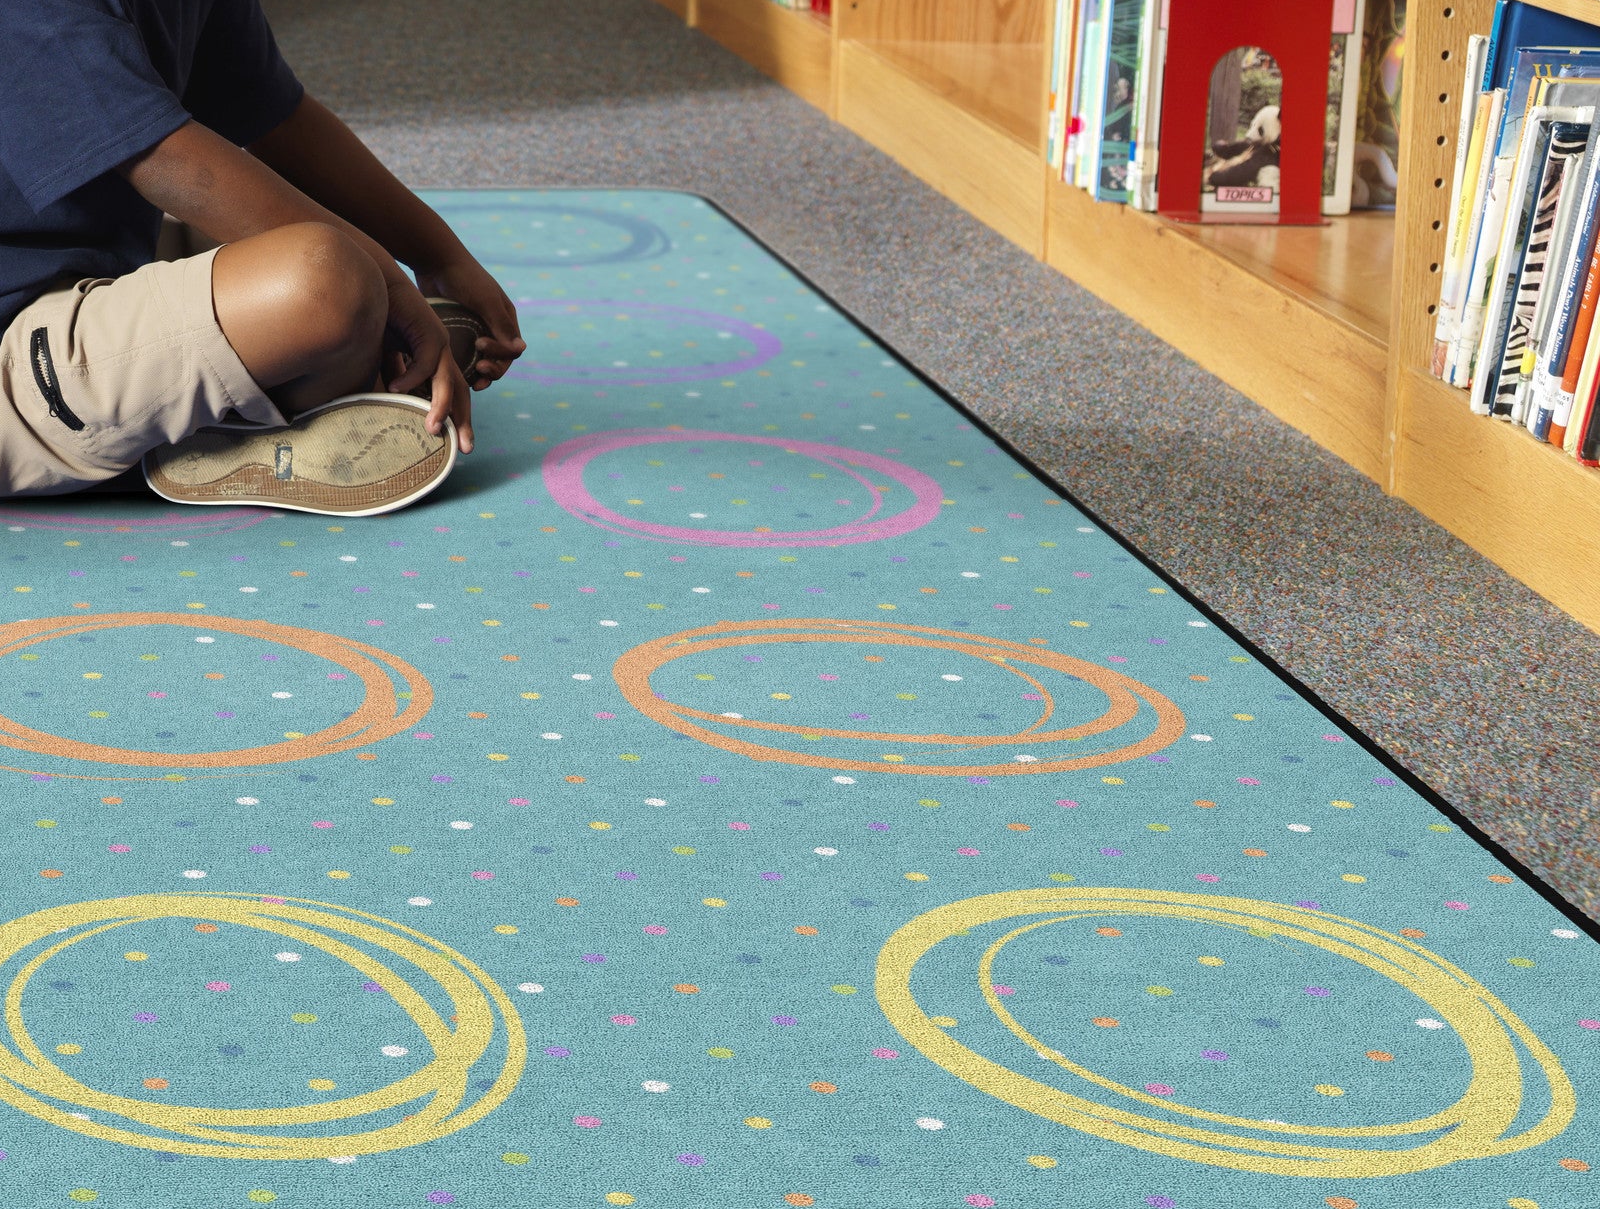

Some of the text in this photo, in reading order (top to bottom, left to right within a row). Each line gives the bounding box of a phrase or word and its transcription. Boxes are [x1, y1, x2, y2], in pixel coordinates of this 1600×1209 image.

[1484, 38, 1497, 83] ANIMALS
[1224, 188, 1266, 201] TOPICS
[1567, 255, 1580, 290] Animals
[1589, 255, 1599, 270] BE
[1583, 273, 1595, 301] EARLY
[1562, 289, 1574, 312] Don't
[1558, 311, 1568, 331] Wear
